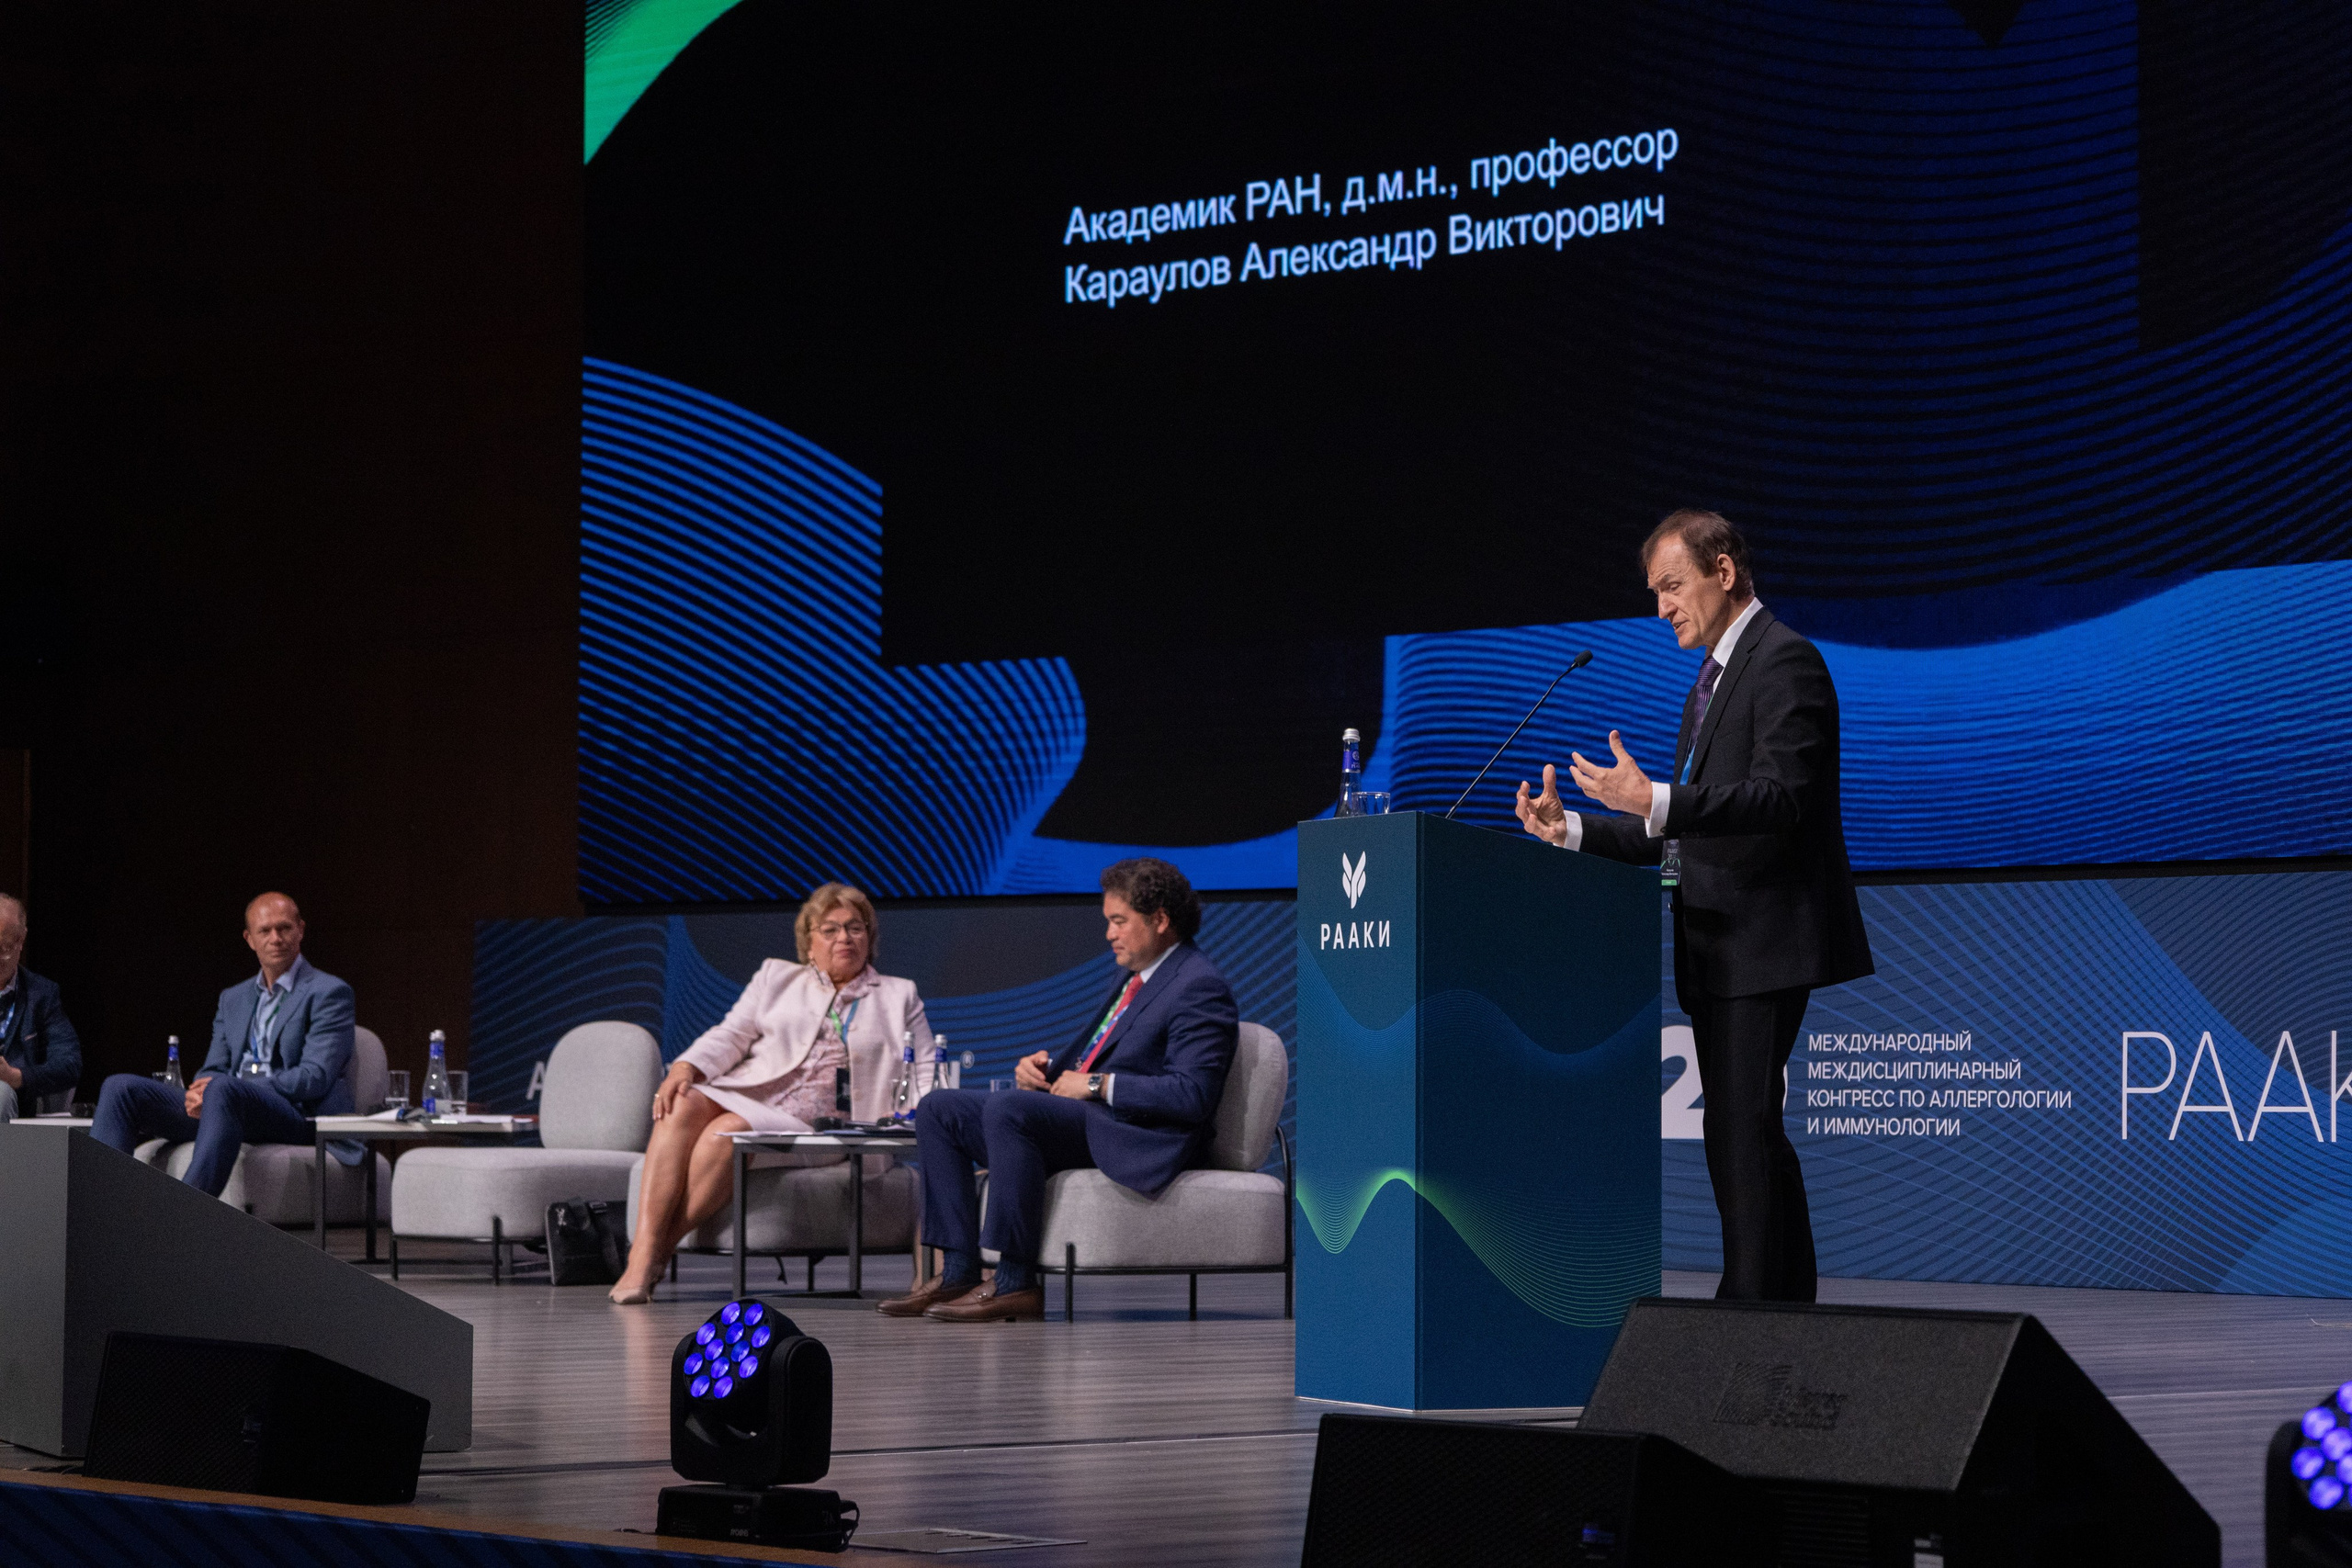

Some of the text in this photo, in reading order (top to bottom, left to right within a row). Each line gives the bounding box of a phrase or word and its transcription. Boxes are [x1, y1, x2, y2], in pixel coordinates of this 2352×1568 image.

[1064, 128, 1679, 245] Академик РАН, д.м.н., профессор
[1065, 195, 1664, 308] Караулов Александр Викторович
[1320, 919, 1390, 951] РААКИ
[1808, 1030, 1973, 1055] МЕЖДУНАРОДНЫЙ
[1807, 1058, 2022, 1082] МЕЖДИСЦИПЛИНАРНЫЙ
[1807, 1089, 2072, 1110] КОНГРЕСС ПО АЛЛЕРГОЛОГИИ
[1807, 1117, 1961, 1136] И ИММУНОЛОГИИ
